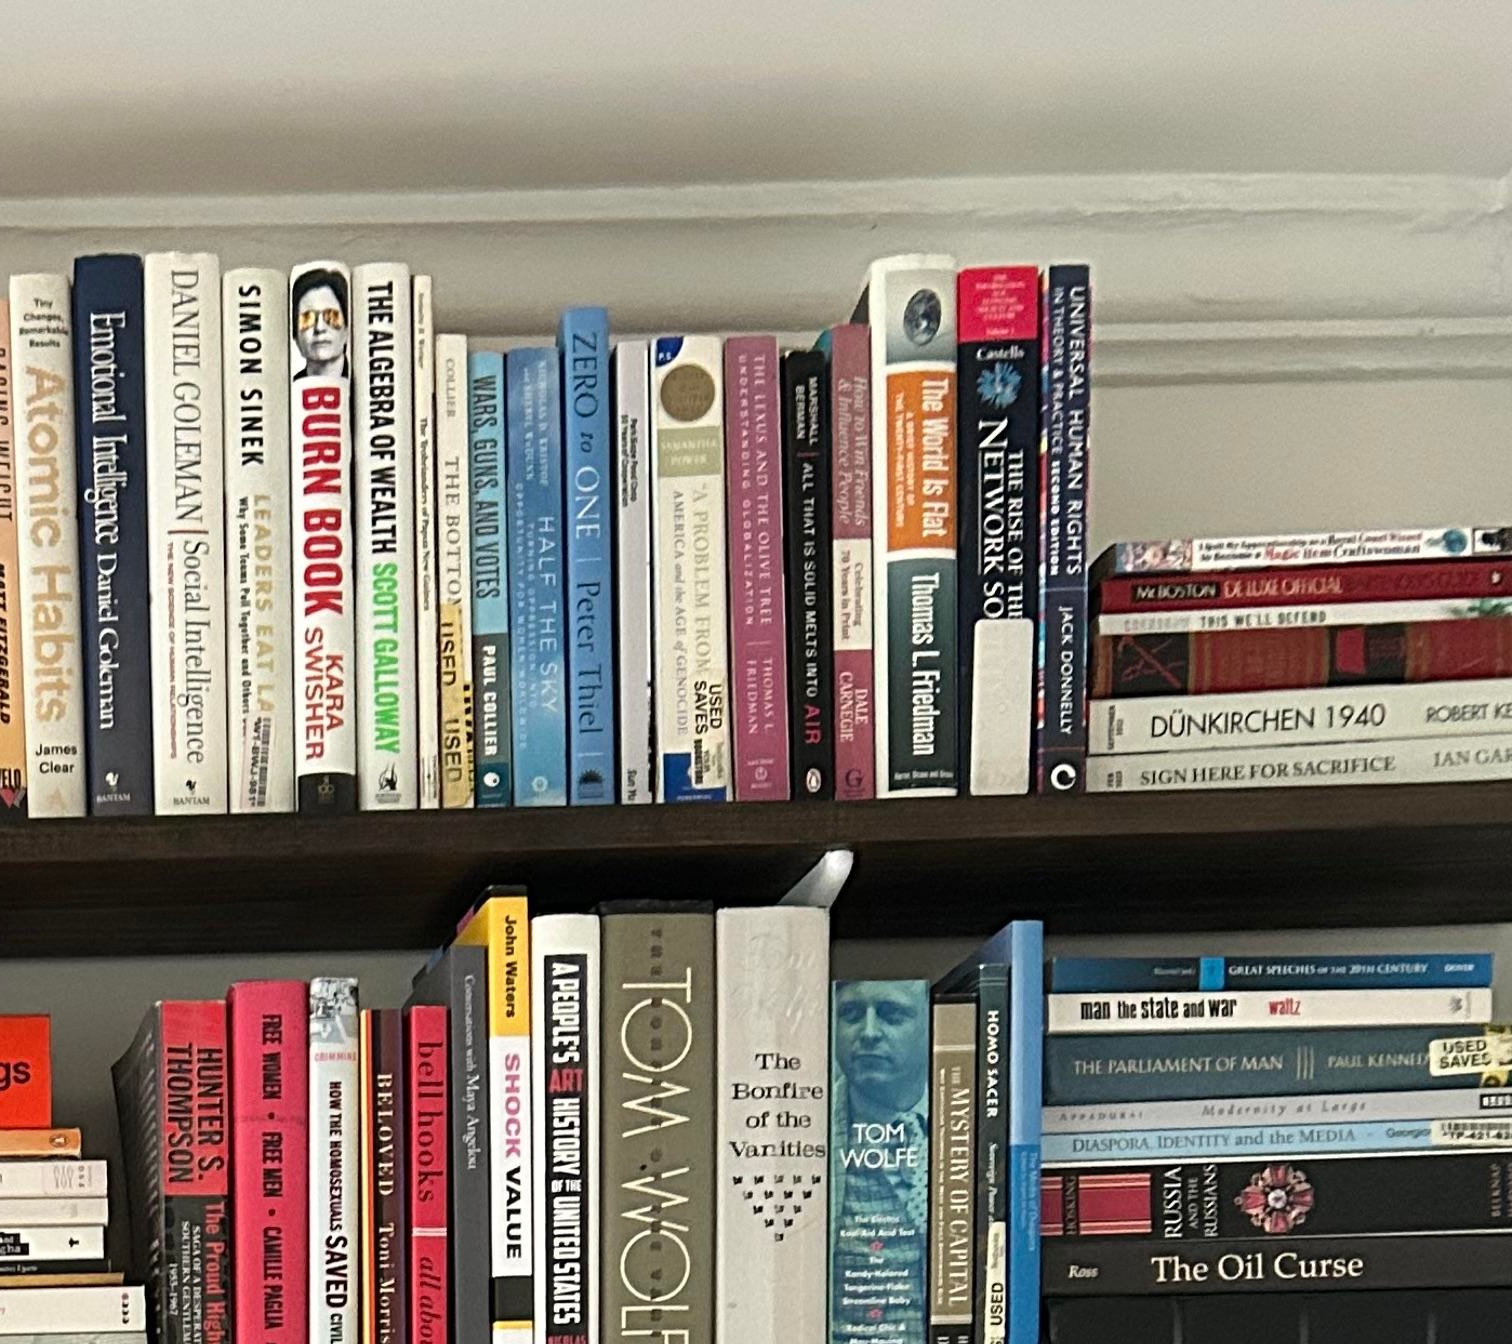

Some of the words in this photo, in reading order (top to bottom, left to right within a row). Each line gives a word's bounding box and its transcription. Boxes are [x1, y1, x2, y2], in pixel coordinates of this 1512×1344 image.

[90, 312, 125, 425] Emotional
[573, 333, 598, 420] ZERO
[26, 367, 60, 548] Atomic
[301, 387, 341, 496] BURN
[582, 432, 593, 453] to
[85, 435, 128, 547] Intelligence
[575, 466, 600, 540] ONE
[97, 554, 118, 639] Daniel
[303, 509, 343, 617] BOOK
[373, 564, 398, 632] SCOTT
[29, 565, 75, 725] Habits
[97, 647, 119, 730] Goleman
[373, 639, 399, 753] GALLOWAY
[1151, 704, 1315, 739] DÜNKIRCHEN
[1326, 703, 1386, 728] 1940
[35, 744, 77, 759] James
[40, 760, 74, 775] Clear
[733, 1082, 823, 1101] Bonfire
[755, 1052, 800, 1071] The
[505, 1054, 520, 1158] SHOCK
[745, 1111, 768, 1129] of
[777, 1111, 812, 1128] the
[853, 1124, 904, 1142] TOM
[728, 1139, 825, 1158] Vanities
[840, 1148, 918, 1169] WOLFE
[505, 1167, 521, 1259] VALUE
[1151, 1255, 1208, 1282] The
[1218, 1255, 1264, 1281] Oil
[1274, 1253, 1364, 1278] Curse
